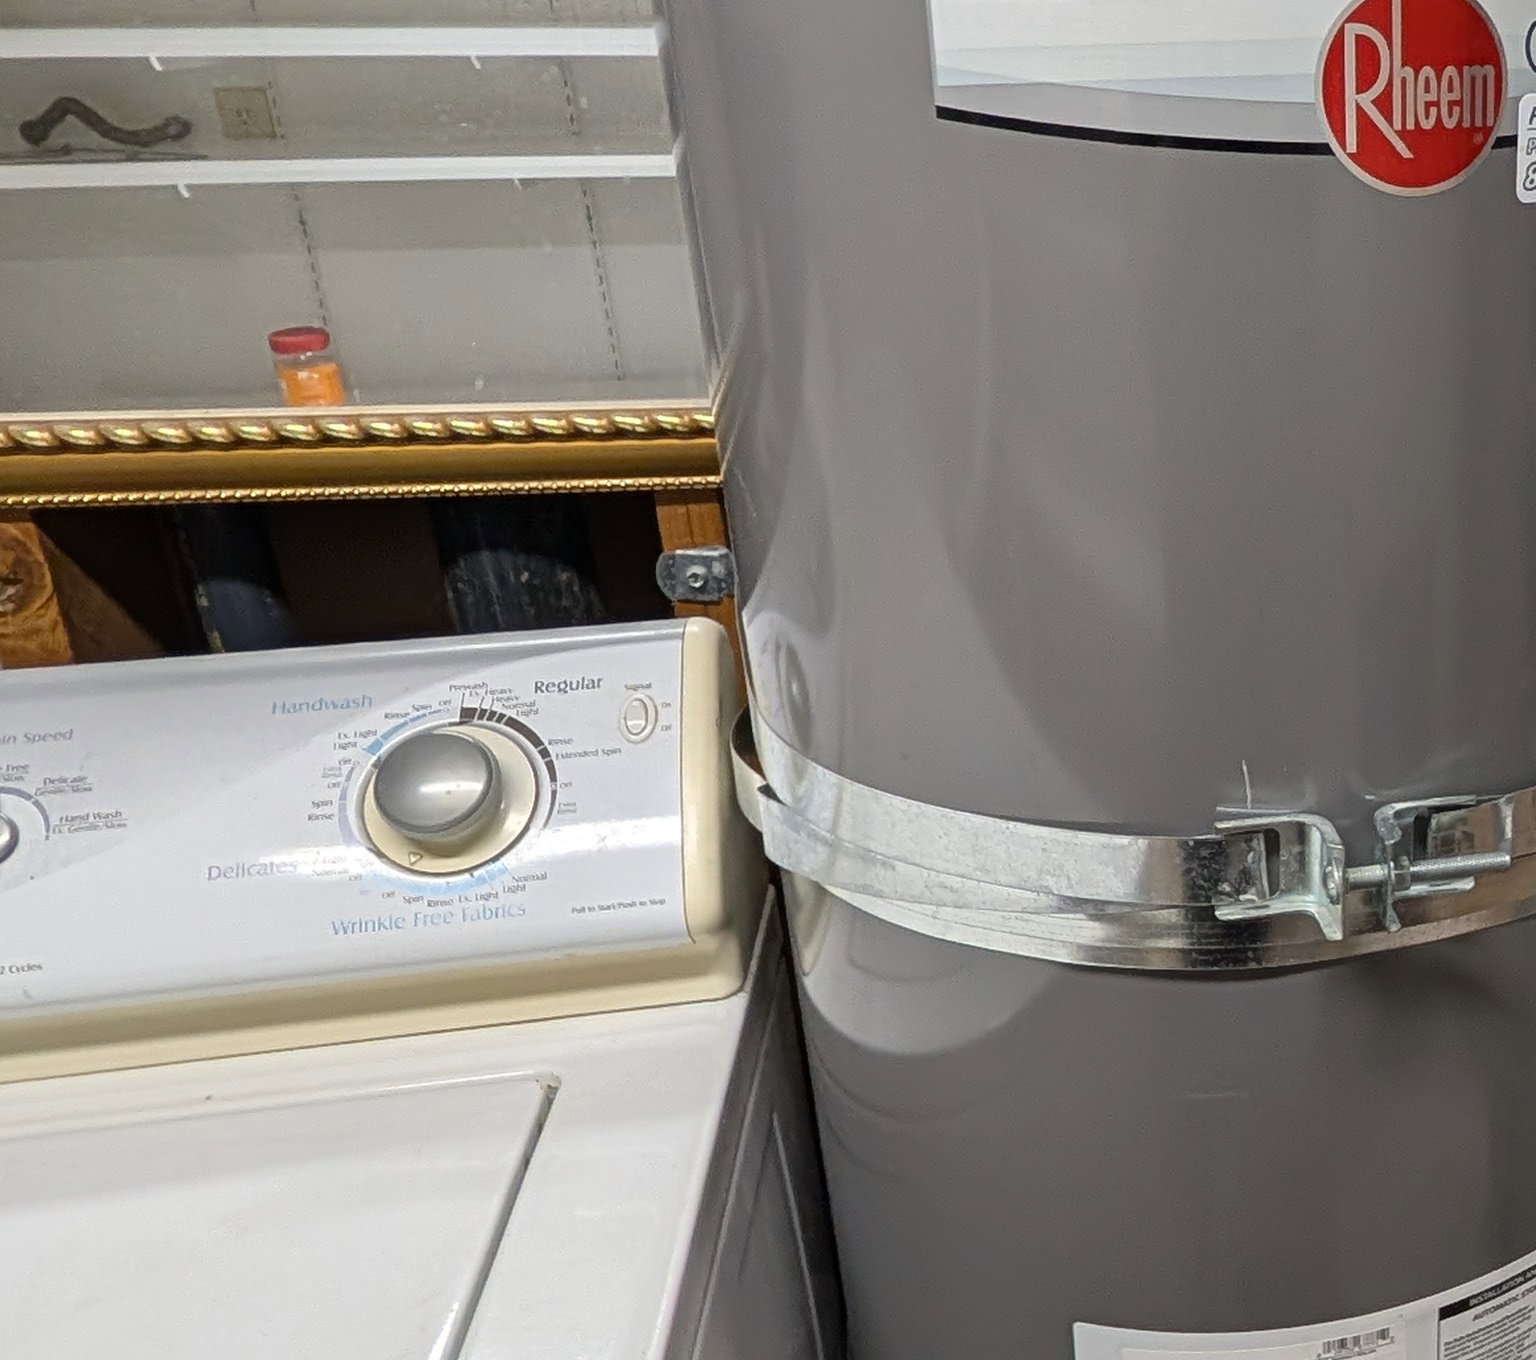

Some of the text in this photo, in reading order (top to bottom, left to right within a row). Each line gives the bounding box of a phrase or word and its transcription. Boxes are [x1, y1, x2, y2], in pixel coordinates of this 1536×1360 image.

[534, 676, 603, 695] Regular
[271, 694, 373, 715] Handwash
[207, 860, 298, 882] Delicates
[332, 902, 527, 936] Wrinkle Free Fabrics
